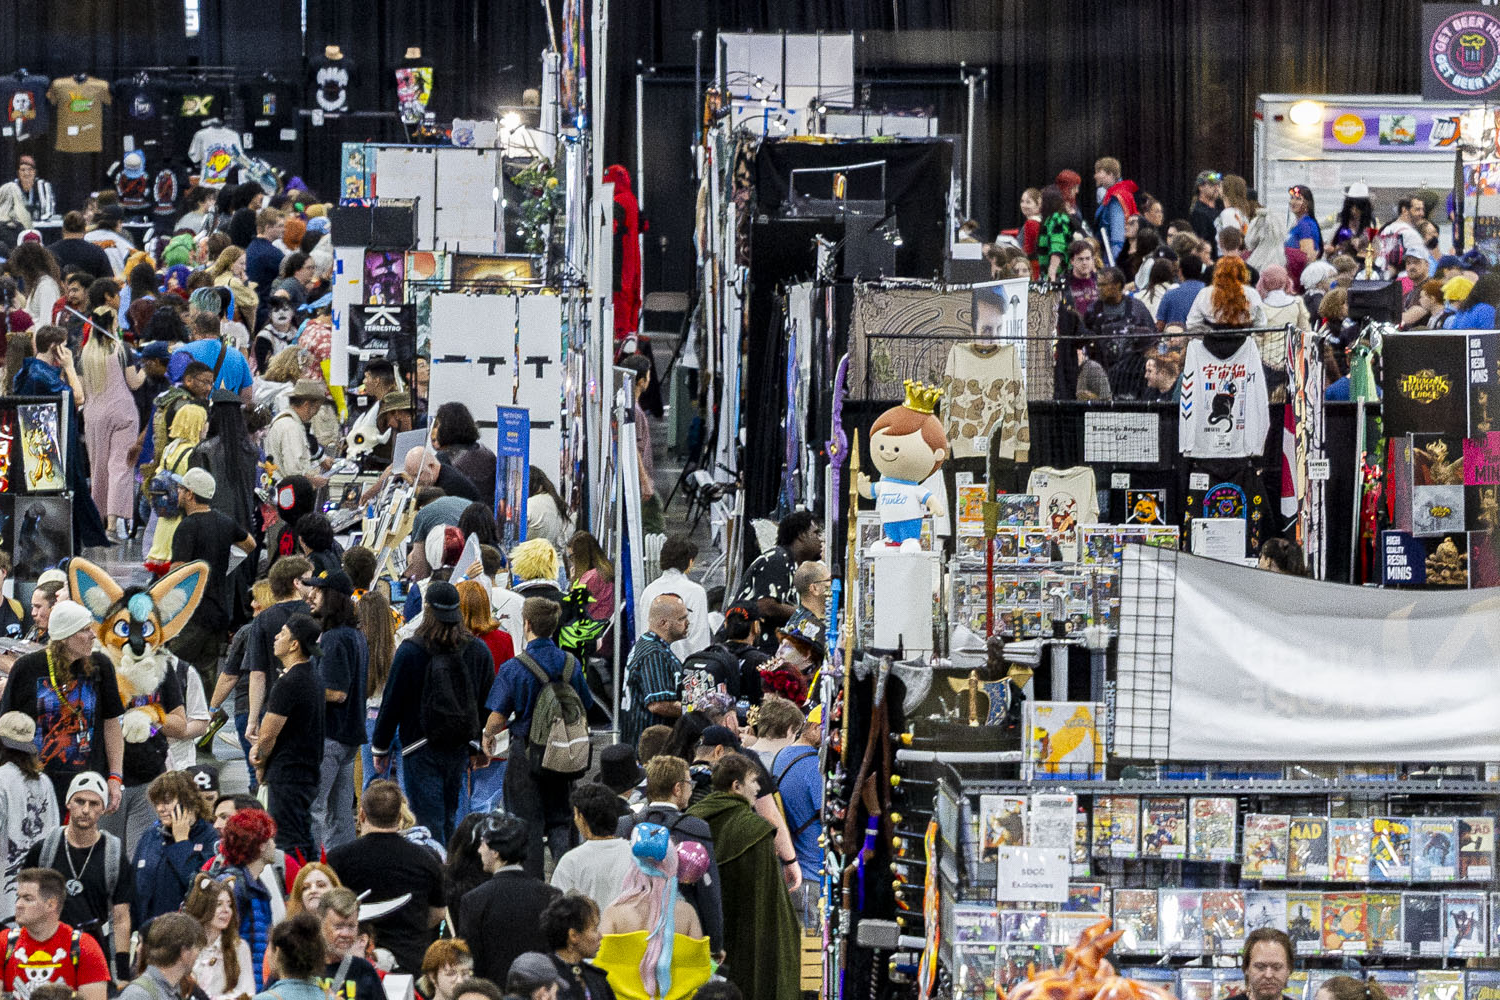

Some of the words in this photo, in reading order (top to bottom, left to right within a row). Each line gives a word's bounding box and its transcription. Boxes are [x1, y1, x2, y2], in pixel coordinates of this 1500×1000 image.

[1452, 16, 1485, 31] BEER
[1402, 380, 1450, 393] TRAPPERS
[1411, 390, 1437, 400] LODGE
[881, 493, 908, 505] Funko
[1386, 536, 1401, 545] HIGH
[1387, 555, 1407, 565] RESIN
[1387, 567, 1412, 580] MINIS
[1291, 823, 1322, 840] MAD
[1021, 868, 1045, 876] SDCC
